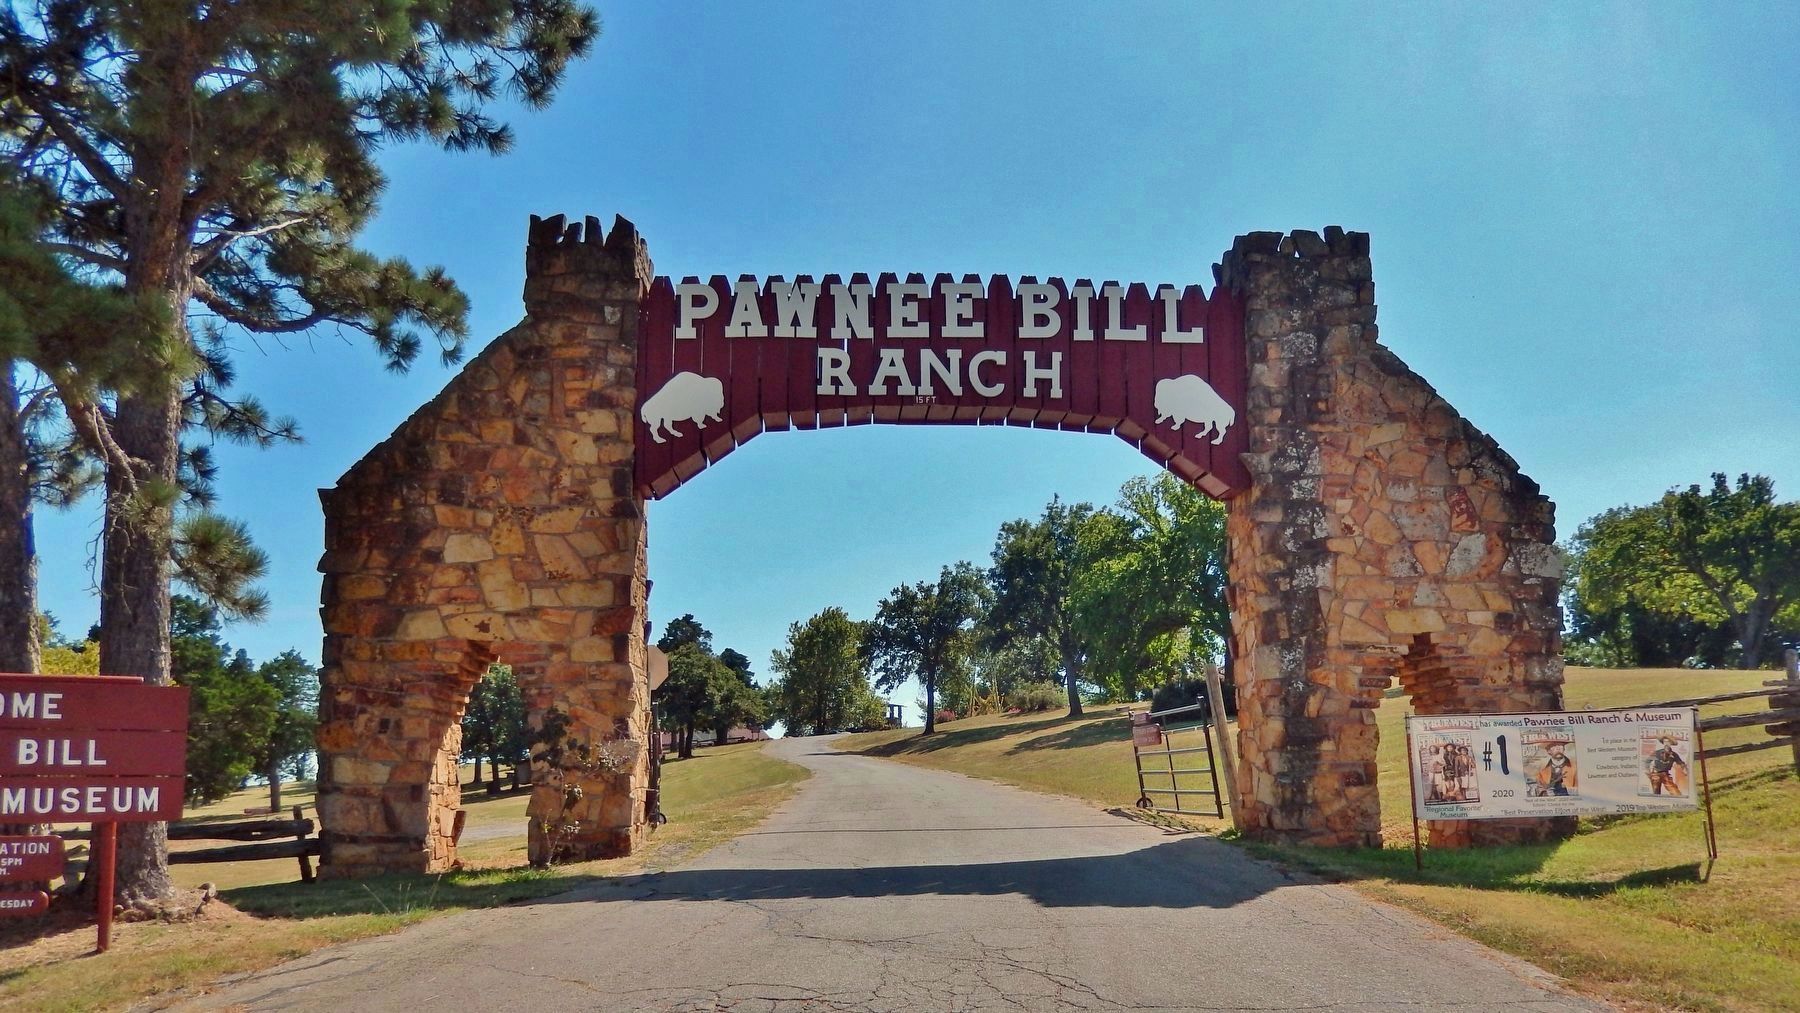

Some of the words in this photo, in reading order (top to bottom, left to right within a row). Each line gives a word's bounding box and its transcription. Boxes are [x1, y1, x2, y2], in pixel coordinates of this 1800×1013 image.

[675, 282, 984, 339] PAWNEE
[1017, 284, 1203, 343] BILL
[817, 347, 1062, 398] RANCH
[916, 396, 924, 404] 15
[926, 396, 936, 404] FT
[0, 693, 63, 719] ME
[1524, 717, 1565, 726] Pawnee
[1568, 716, 1585, 725] Bill
[1588, 714, 1619, 724] Ranch
[1623, 713, 1633, 722] &
[1636, 712, 1682, 722] Museum
[18, 738, 107, 765] BILL
[1483, 735, 1510, 775] #1
[2, 787, 160, 814] MUSEUM
[1492, 790, 1514, 798] 2020
[1616, 804, 1635, 813] 2019
